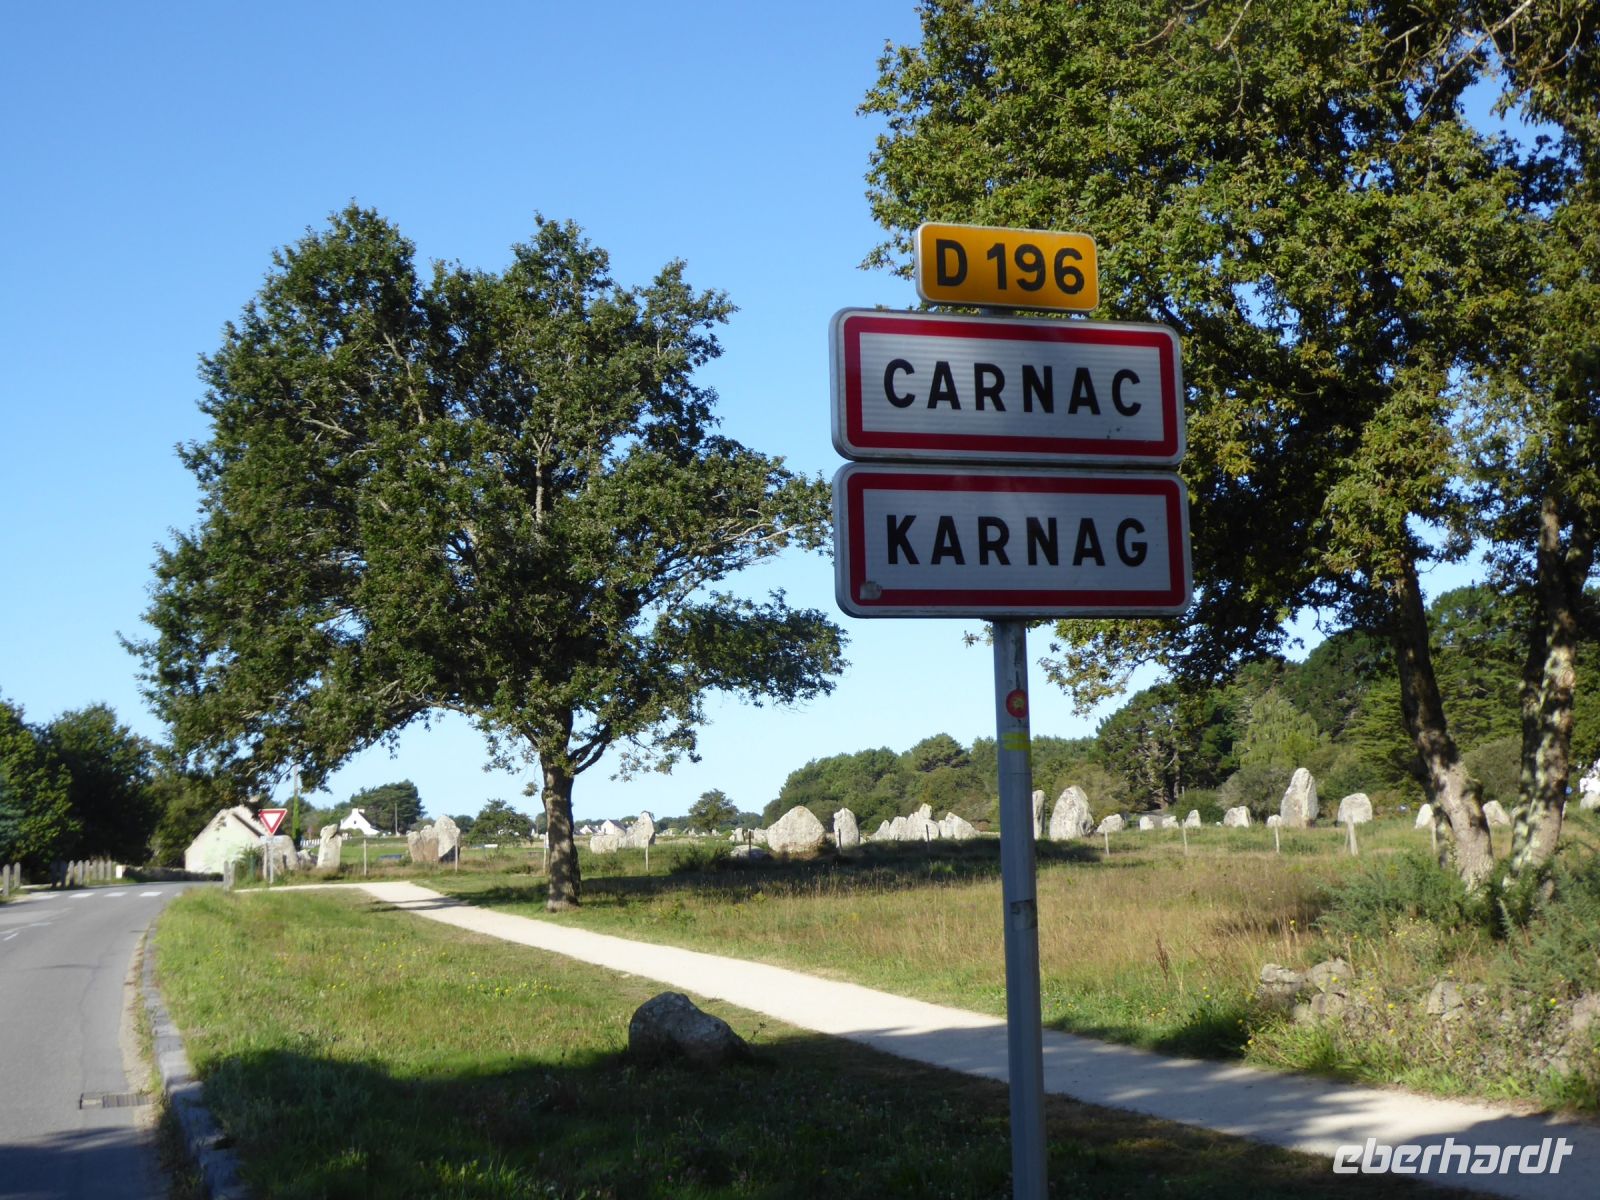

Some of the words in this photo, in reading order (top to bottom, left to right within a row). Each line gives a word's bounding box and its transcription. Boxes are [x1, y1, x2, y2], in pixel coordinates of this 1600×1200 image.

[936, 238, 968, 287] D
[986, 242, 1085, 294] 196
[883, 358, 1142, 417] CARNAC
[886, 514, 1148, 568] KARNAG
